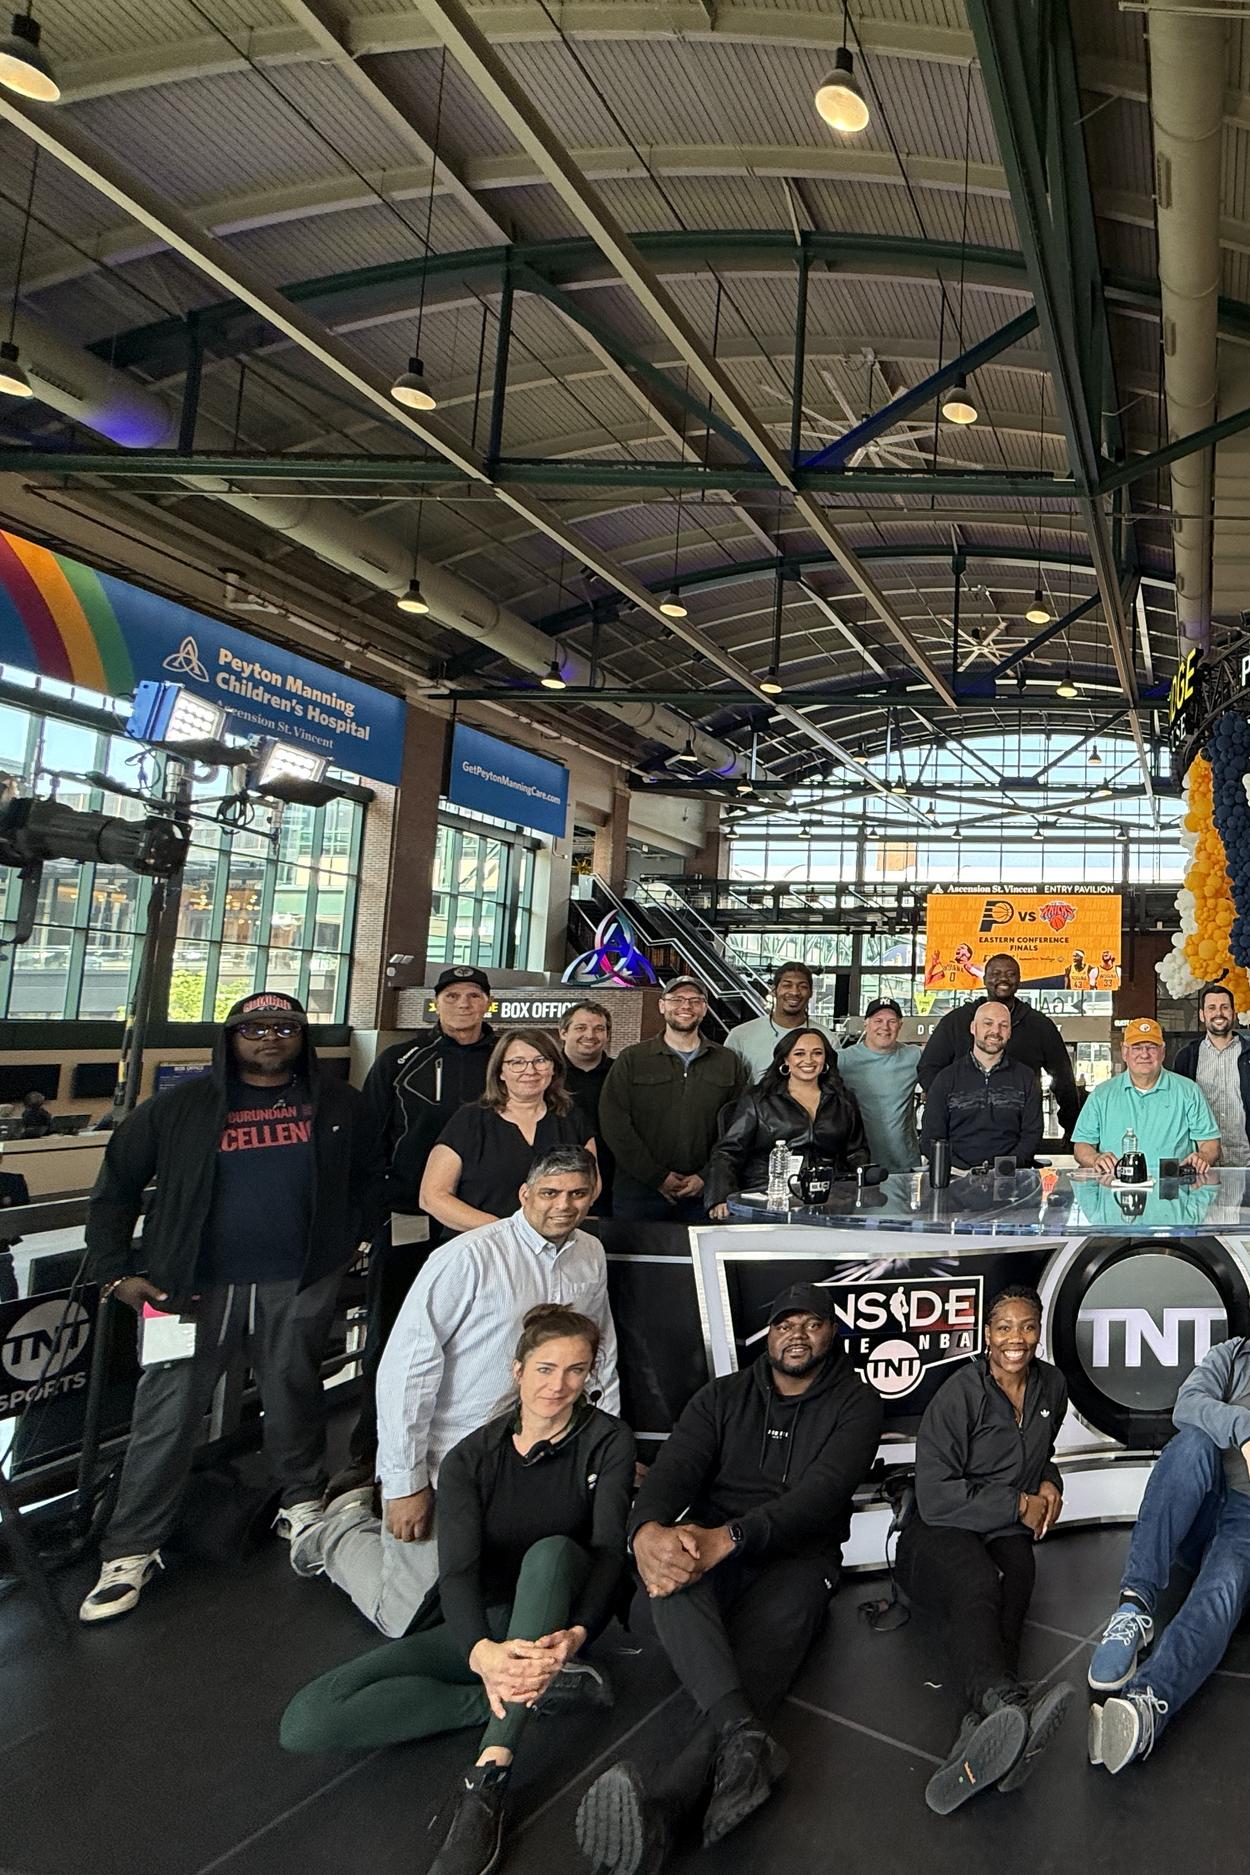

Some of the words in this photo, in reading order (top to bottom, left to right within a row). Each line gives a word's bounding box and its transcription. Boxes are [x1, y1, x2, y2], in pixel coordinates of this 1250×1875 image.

[218, 647, 282, 687] Peyton
[285, 675, 356, 717] Manning
[216, 672, 304, 716] Children's
[307, 705, 371, 741] Hospital
[277, 721, 292, 735] St.
[293, 726, 334, 749] Vincent
[462, 761, 561, 805] GetPeytonManningCare.com
[947, 884, 991, 894] Ascension
[992, 885, 1003, 894] St.
[1003, 885, 1037, 894] Vincent
[1044, 885, 1073, 894] ENTRY
[1074, 885, 1114, 894] PAVILION
[1018, 911, 1037, 922] VS
[979, 936, 1015, 944] EASTERN
[1016, 936, 1069, 944] CONFERENCE
[949, 972, 956, 982] 0
[1073, 980, 1083, 988] 43
[1103, 979, 1113, 987] 33
[501, 1002, 530, 1018] BOX
[3, 1317, 92, 1366] TNT
[918, 1332, 971, 1350] NBA
[1078, 1308, 1228, 1367] TNT
[868, 1356, 921, 1379] TNT
[0, 1371, 86, 1413] SPORTS
